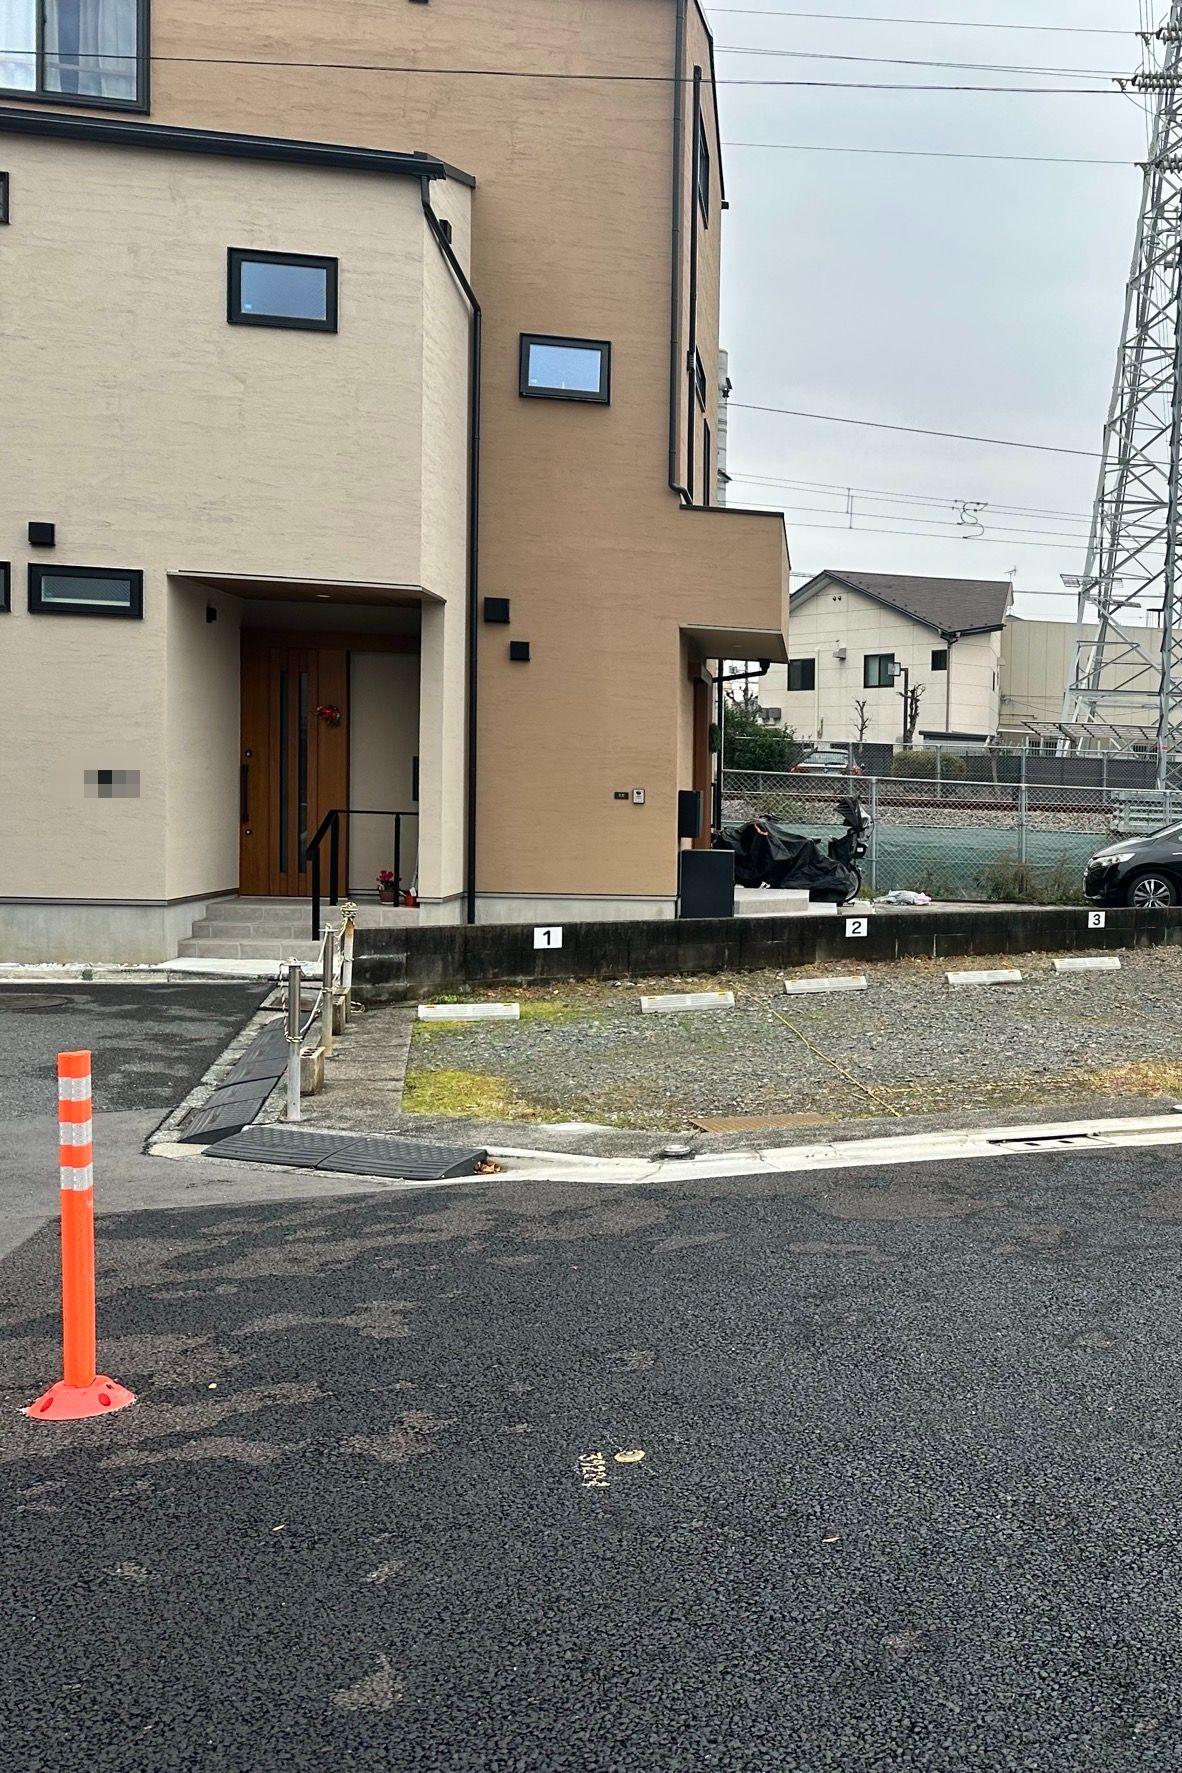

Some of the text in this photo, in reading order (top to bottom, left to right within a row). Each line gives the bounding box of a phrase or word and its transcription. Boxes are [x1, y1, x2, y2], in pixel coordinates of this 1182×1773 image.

[1092, 913, 1101, 926] 3
[851, 920, 862, 935] 2
[542, 929, 551, 946] 1
